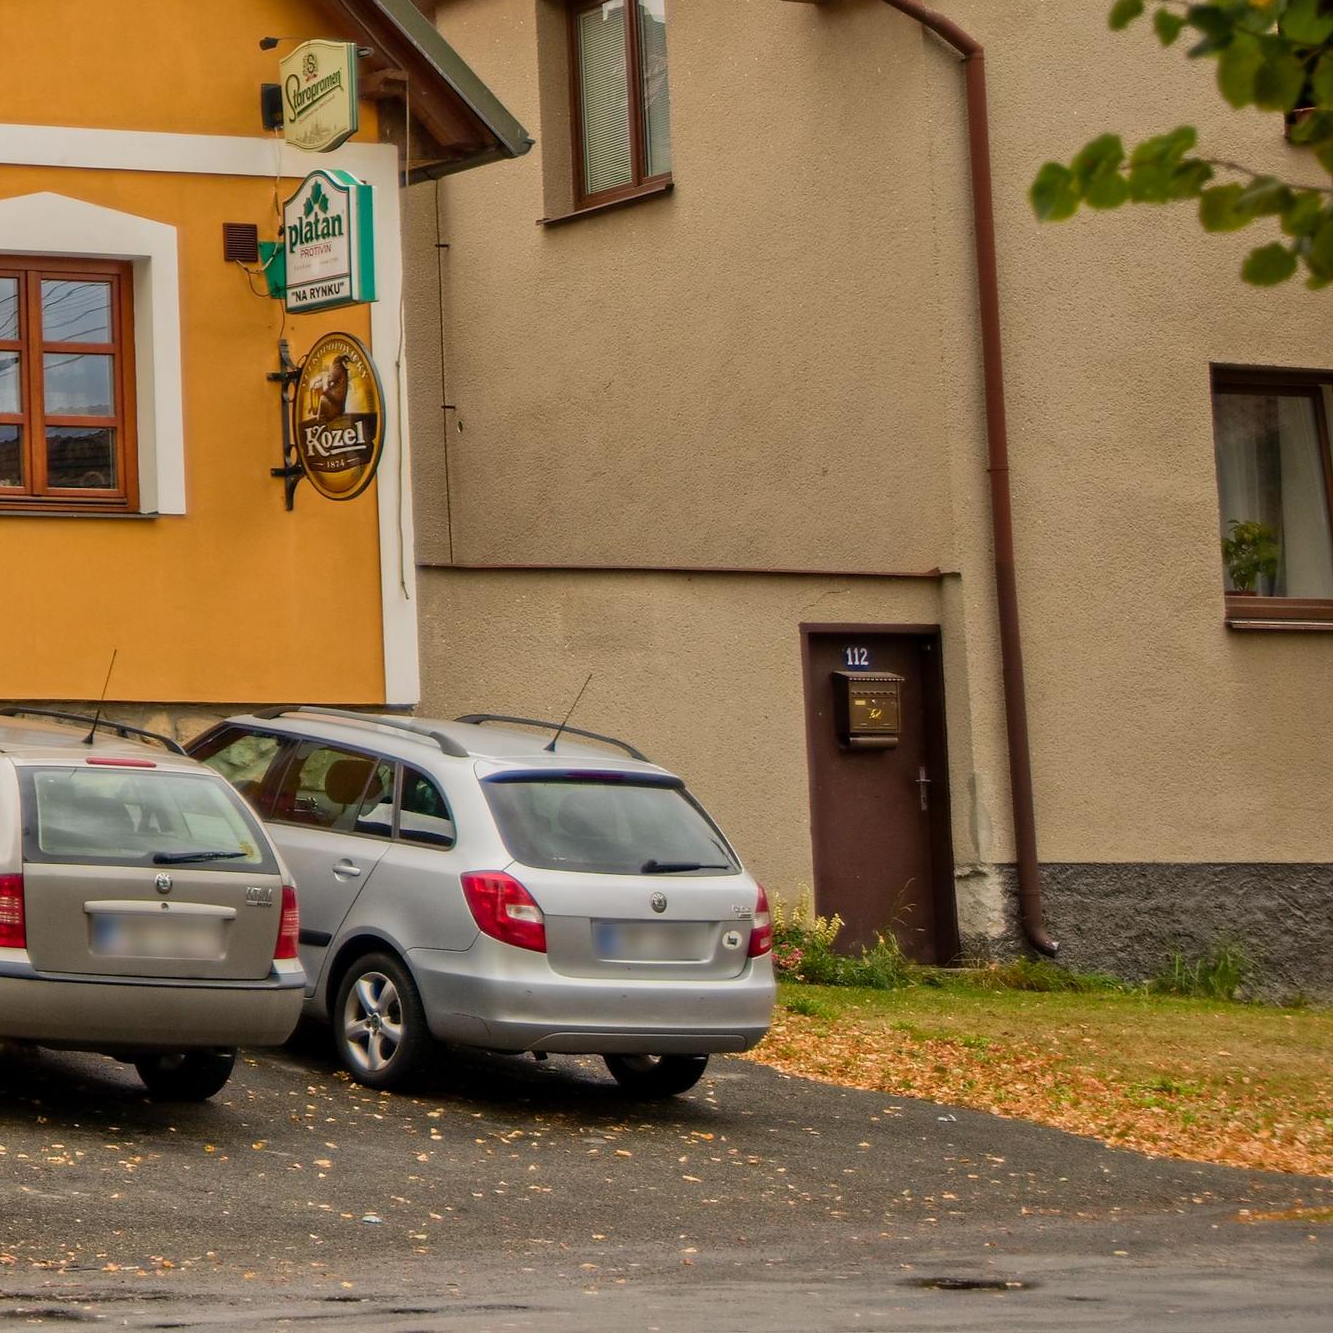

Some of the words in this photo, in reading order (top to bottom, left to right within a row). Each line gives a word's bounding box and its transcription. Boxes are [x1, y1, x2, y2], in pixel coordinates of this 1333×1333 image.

[286, 70, 343, 123] Staropramen
[287, 212, 344, 254] platan
[309, 282, 345, 299] RYNKU"
[305, 420, 366, 457] Kozel
[846, 647, 869, 665] 112
